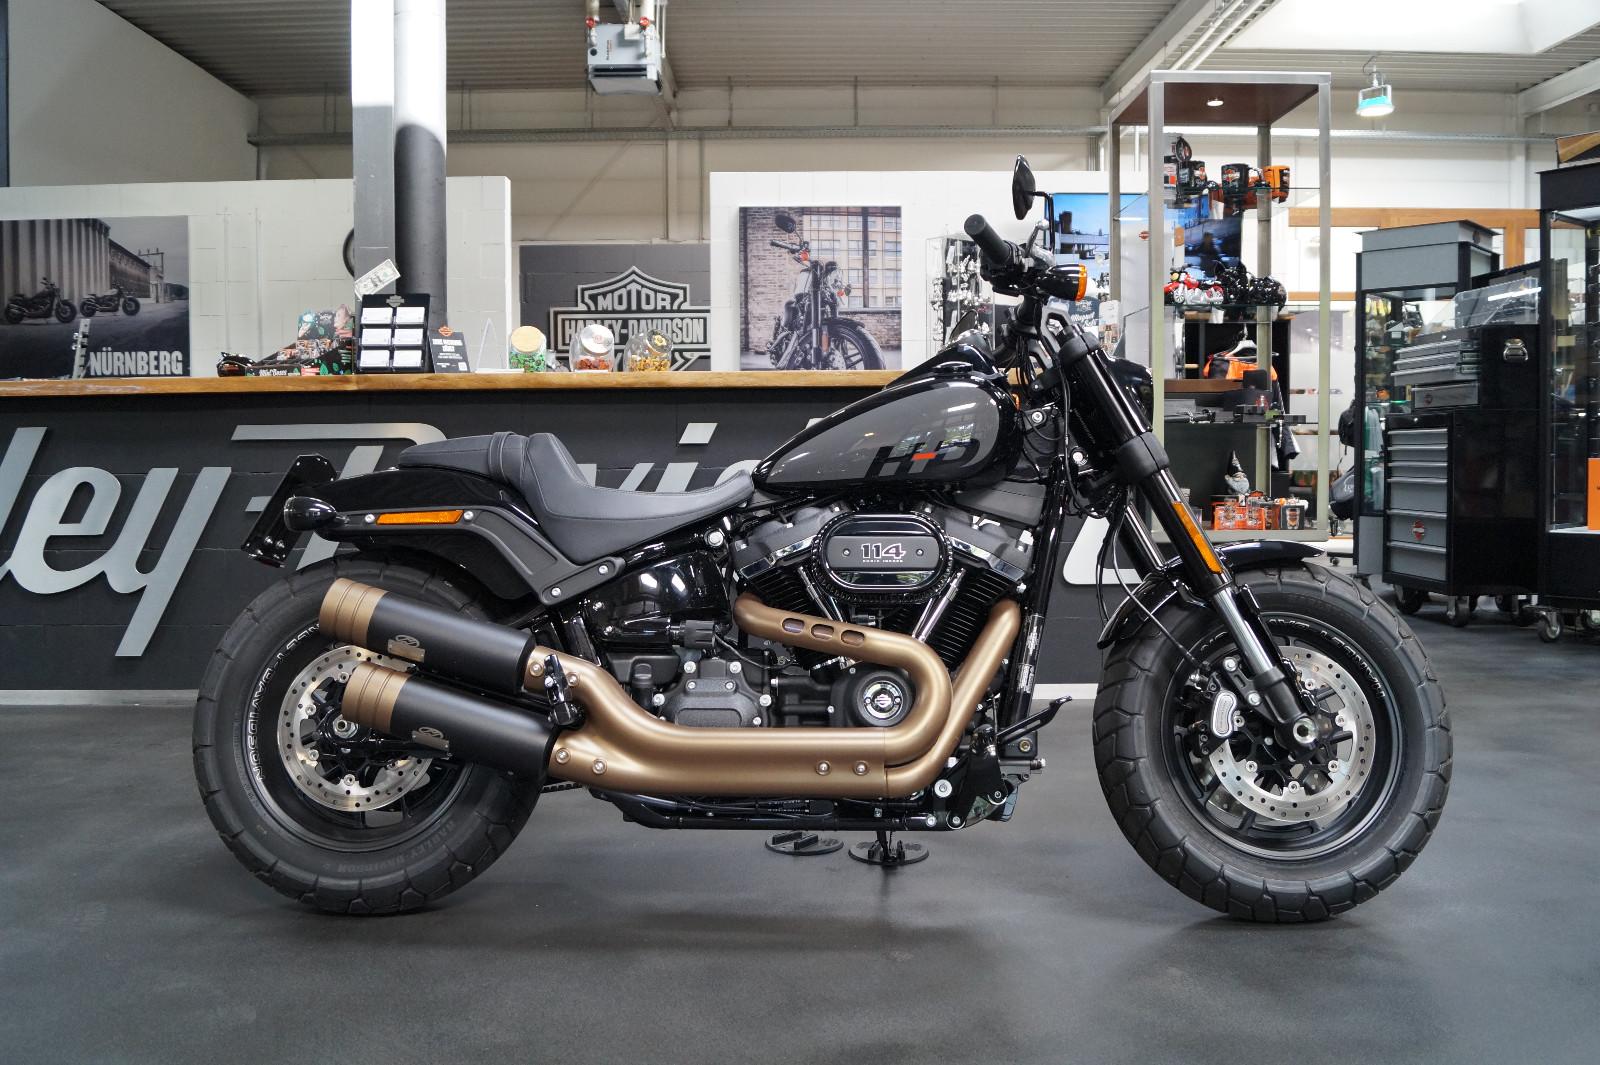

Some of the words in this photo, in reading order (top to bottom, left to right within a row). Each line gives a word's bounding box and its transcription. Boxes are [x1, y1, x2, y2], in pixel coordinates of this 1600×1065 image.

[597, 282, 672, 311] MOTOR
[89, 346, 184, 376] NÜRNBERG
[861, 542, 907, 560] 114
